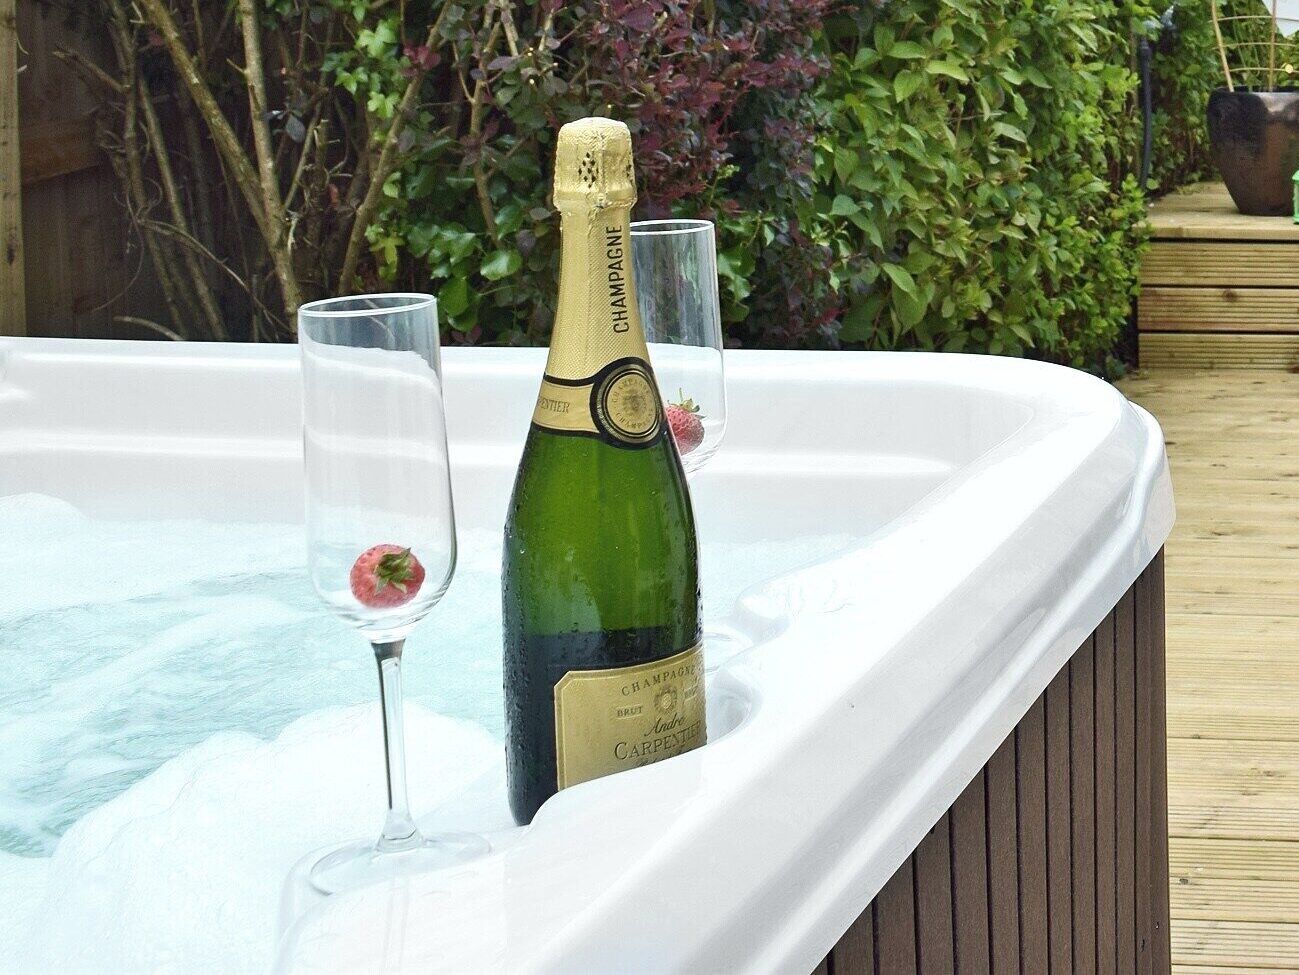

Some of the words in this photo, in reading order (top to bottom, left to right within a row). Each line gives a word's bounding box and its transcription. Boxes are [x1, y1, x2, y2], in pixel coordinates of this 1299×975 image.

[606, 225, 629, 333] CHAMPAGNE
[621, 666, 696, 696] CHAMPAGNE
[617, 707, 643, 717] BRUT
